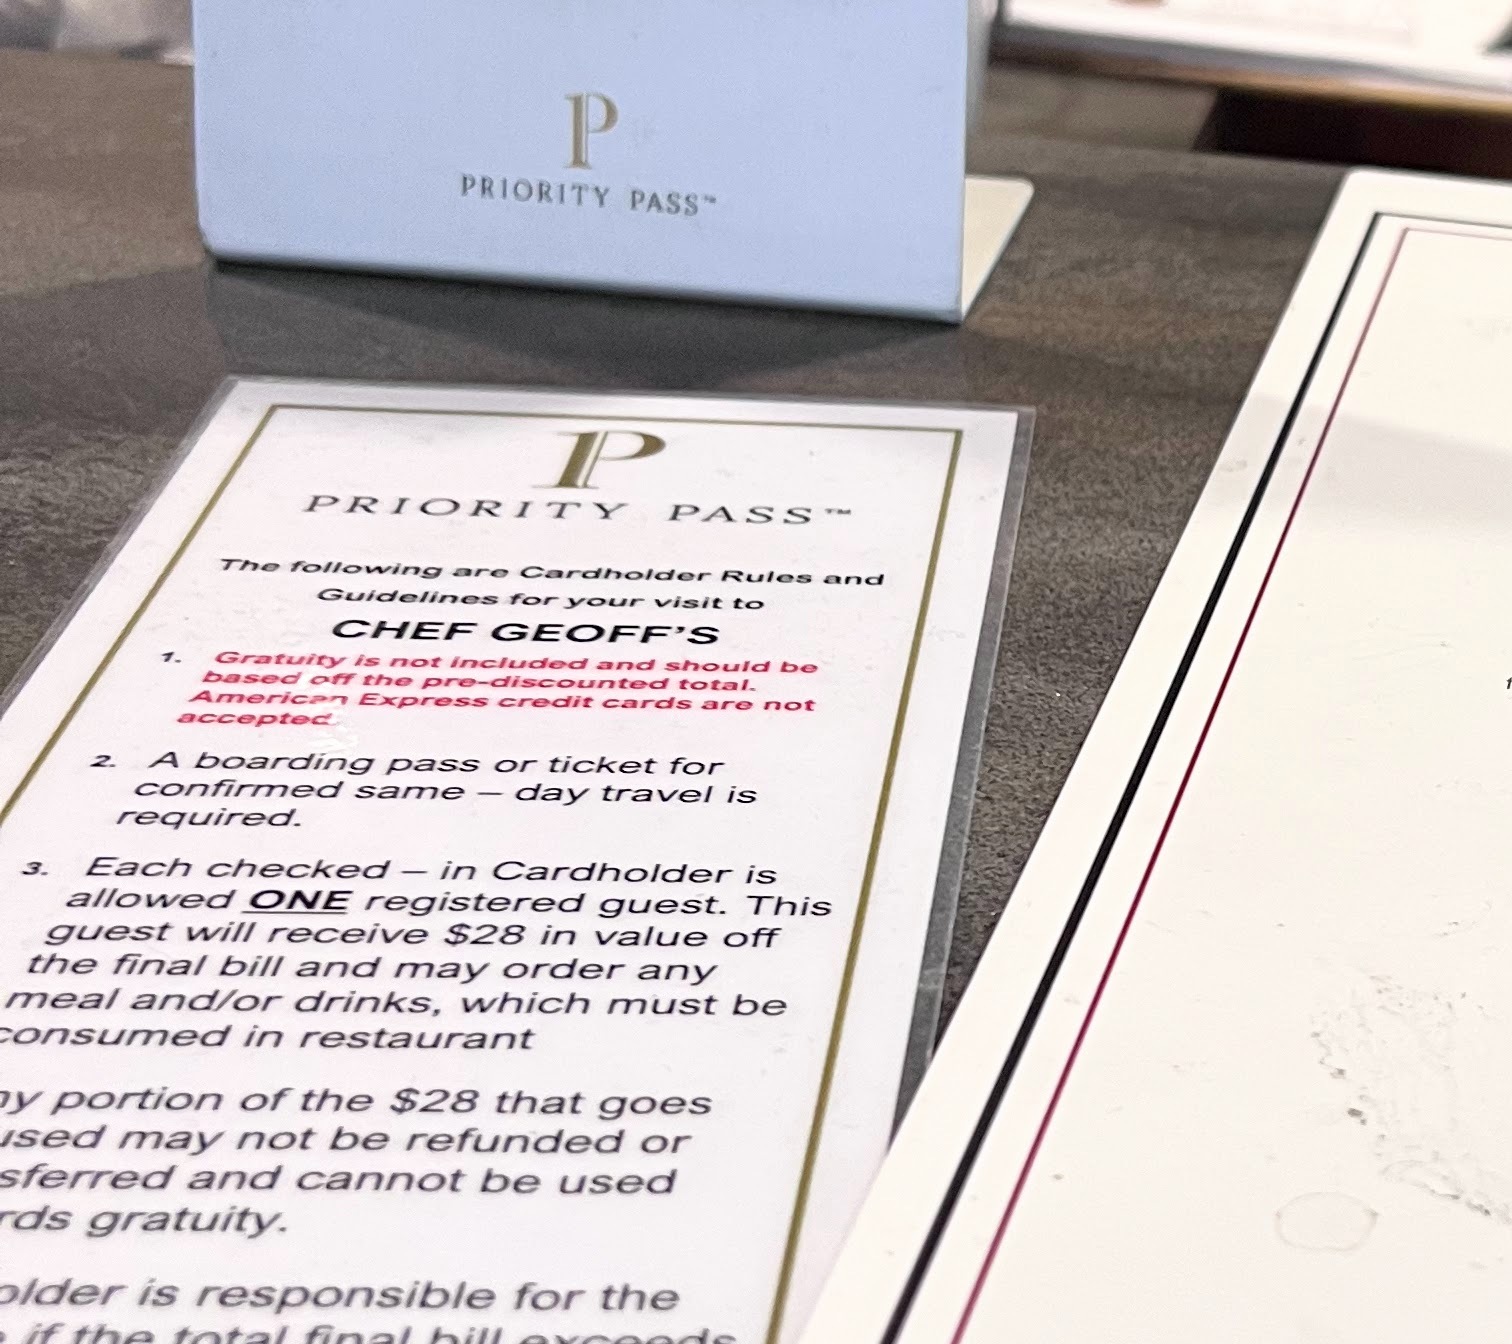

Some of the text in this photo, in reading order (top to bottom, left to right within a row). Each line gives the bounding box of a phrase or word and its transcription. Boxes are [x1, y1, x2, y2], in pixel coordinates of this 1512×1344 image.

[460, 173, 611, 209] PRIORITY
[303, 494, 628, 520] PRIORITY
[220, 558, 885, 586] The following are Cardholder Rules and
[316, 587, 765, 610] Guidelines for your visit to
[331, 619, 479, 641] CHEF
[214, 651, 348, 670] Gratuity
[353, 653, 381, 668] is
[388, 656, 443, 669] not
[449, 655, 589, 671] included
[595, 658, 657, 672] and
[663, 659, 772, 673] should
[779, 660, 819, 674] be
[147, 751, 180, 769] A
[193, 751, 376, 776] boarding
[384, 758, 481, 776] pass
[493, 759, 539, 774] or
[548, 755, 659, 775] ticket
[669, 756, 726, 776] for
[85, 856, 193, 878] Each
[206, 858, 392, 880] checked
[439, 860, 477, 881] in
[492, 860, 734, 884] Cardholder
[745, 864, 778, 885] is
[65, 887, 832, 919] allowed ONE registered guest. This
[4, 987, 788, 1018] meal and/or drinks, which must be
[49, 1086, 713, 1122] portion of the $28 that goes
